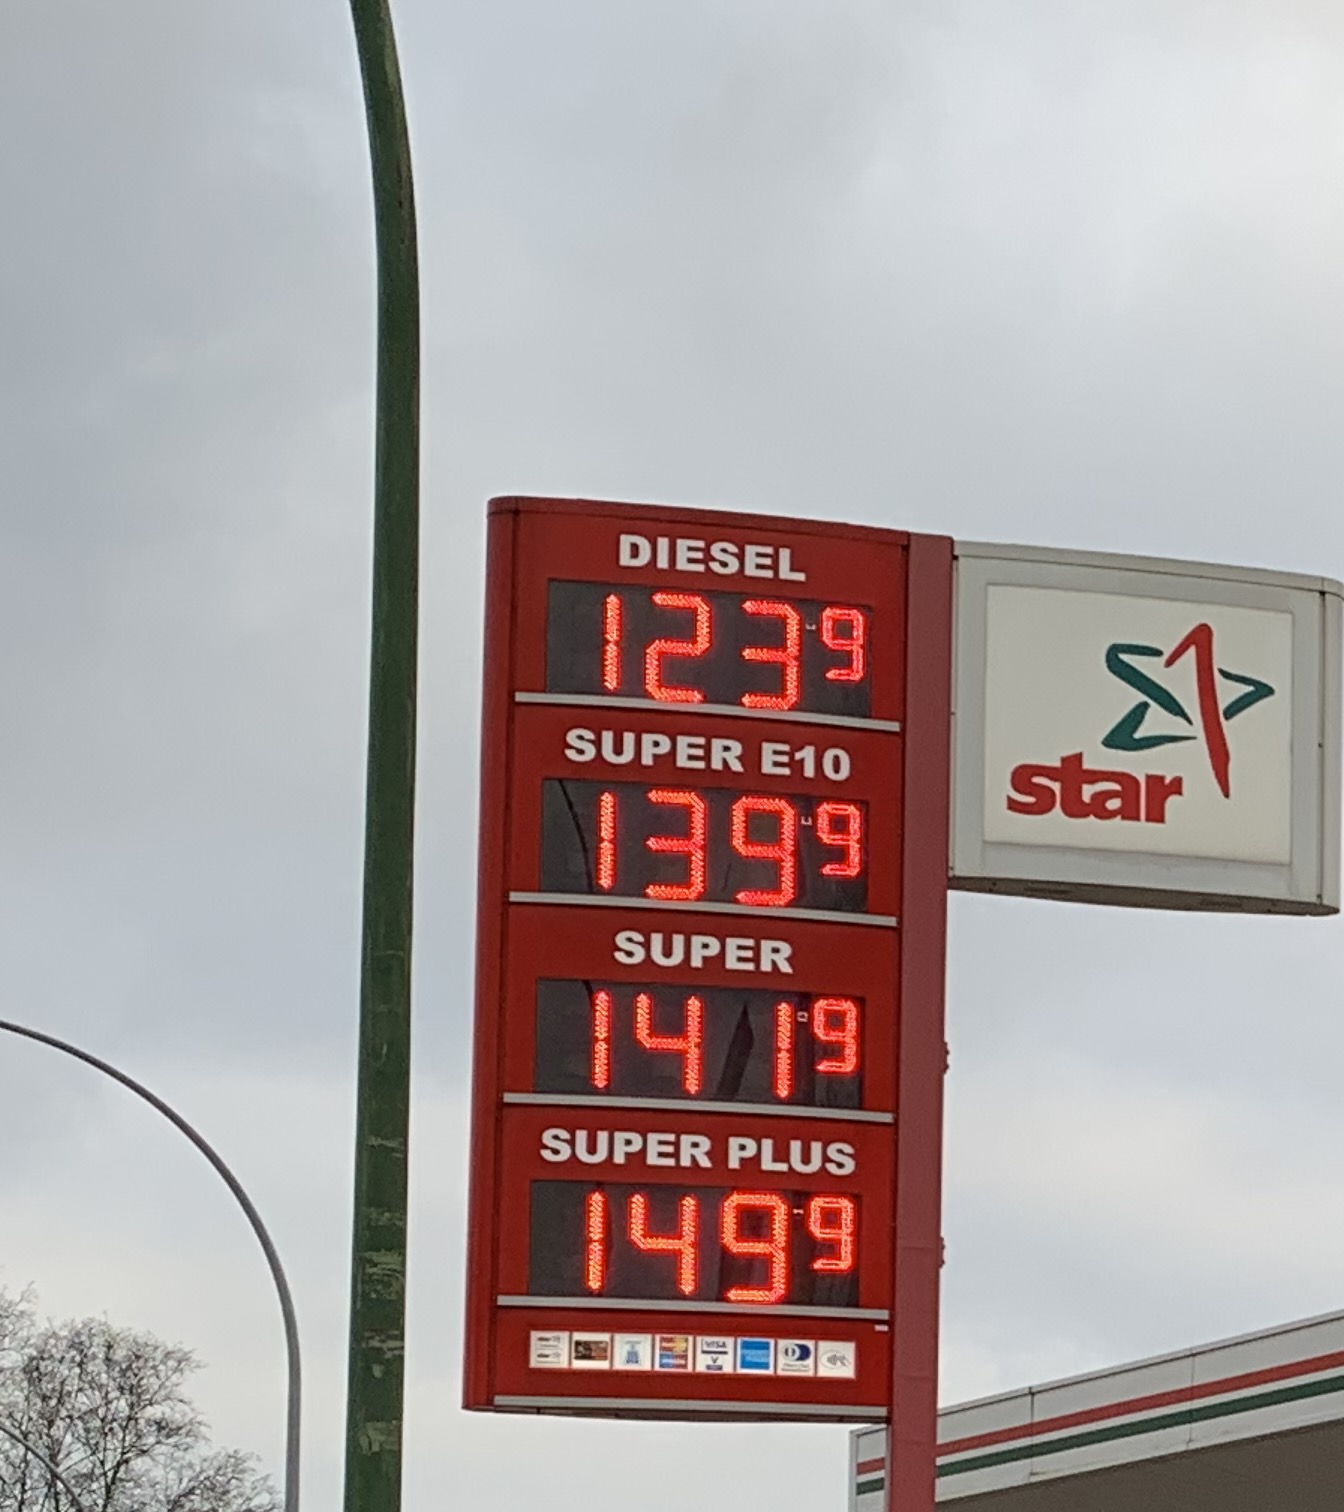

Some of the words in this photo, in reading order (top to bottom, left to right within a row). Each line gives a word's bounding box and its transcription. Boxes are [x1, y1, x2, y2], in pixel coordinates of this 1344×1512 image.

[618, 534, 806, 582] DIESEL
[564, 728, 744, 773] SUPER
[760, 743, 851, 782] E10
[1006, 752, 1183, 824] star
[613, 930, 793, 974] SUPER
[540, 1128, 712, 1169] SUPER
[728, 1137, 856, 1176] PLUS
